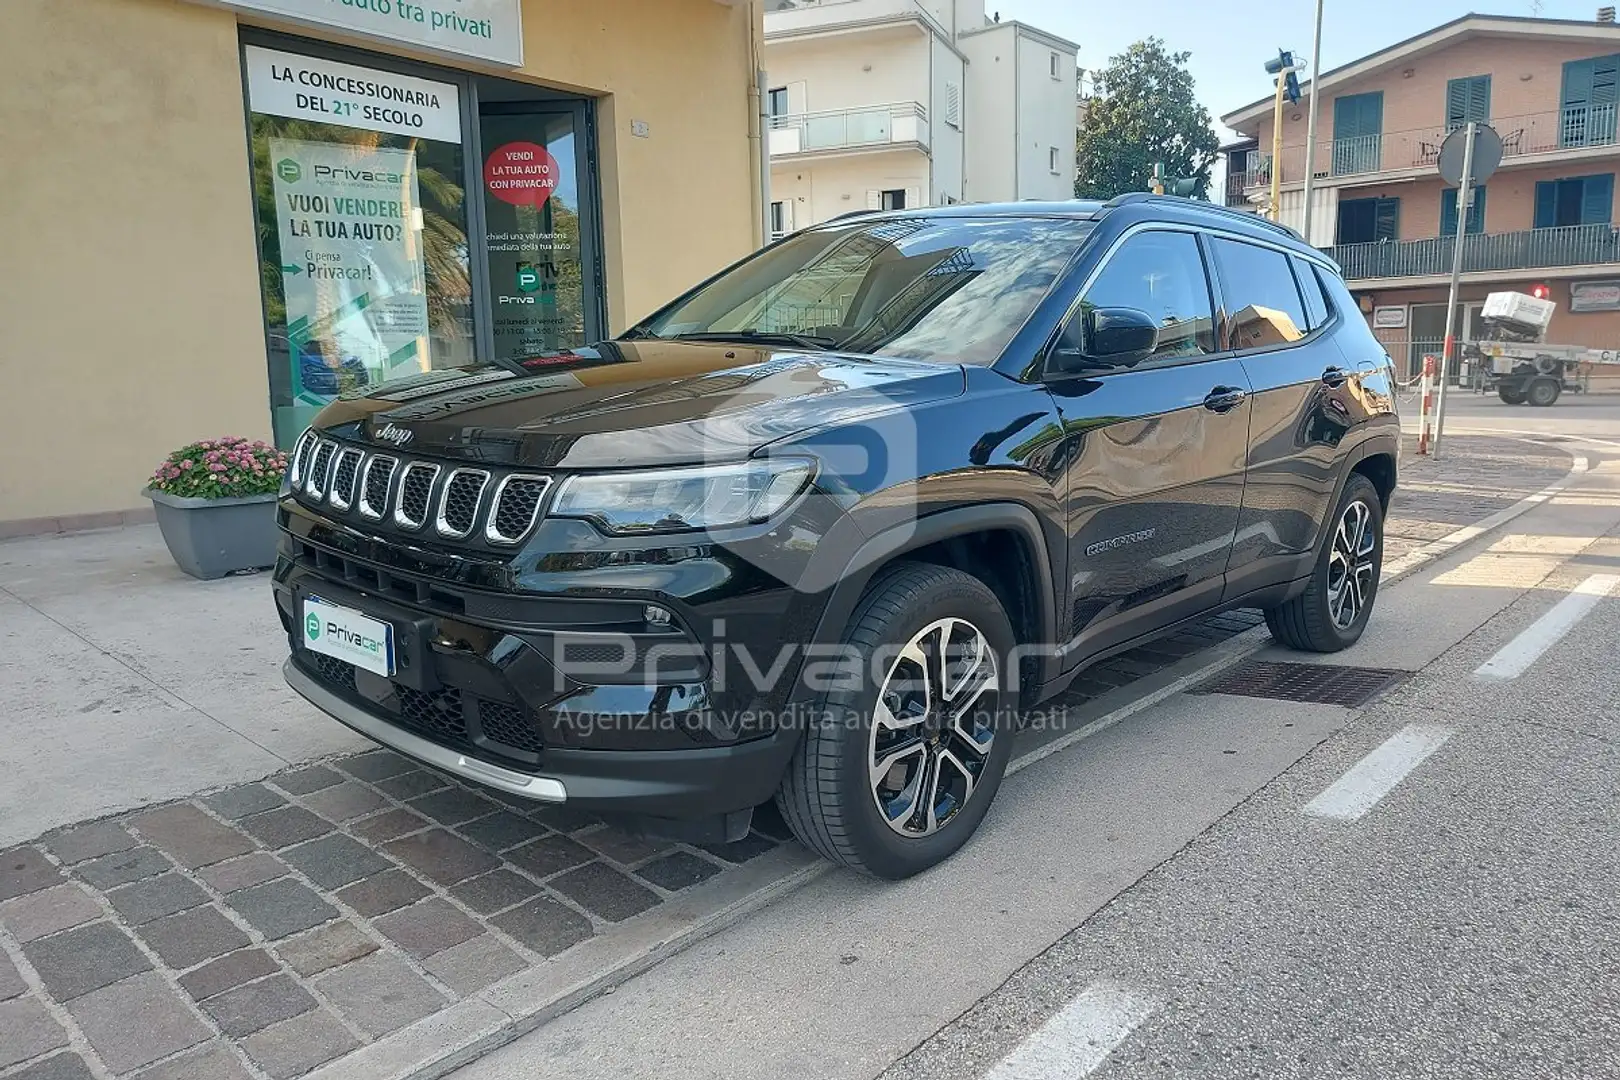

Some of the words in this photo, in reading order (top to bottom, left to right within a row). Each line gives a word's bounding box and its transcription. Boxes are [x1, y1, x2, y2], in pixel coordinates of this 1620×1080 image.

[399, 2, 425, 22] tra
[431, 10, 492, 39] privati
[271, 64, 294, 83] LA
[298, 70, 441, 109] CONCESSIONARIA
[295, 93, 329, 113] DEL
[333, 100, 359, 116] 21°
[363, 105, 423, 128] SECOLO
[505, 151, 533, 161] VENDI
[314, 165, 411, 184] Privacar
[492, 166, 504, 176] LA
[505, 165, 524, 175] TUA
[524, 164, 549, 174] AUTO
[489, 180, 509, 189] CON
[510, 178, 554, 189] PRIVACAR
[287, 193, 330, 214] VUOI
[290, 219, 311, 238] LA
[314, 220, 348, 239] TUA
[352, 222, 402, 242] AUTO?
[304, 249, 313, 260] Ci
[315, 251, 341, 263] pensa
[307, 262, 372, 280] Privacar!
[375, 422, 415, 447] Jeep
[326, 621, 384, 653] Privacar
